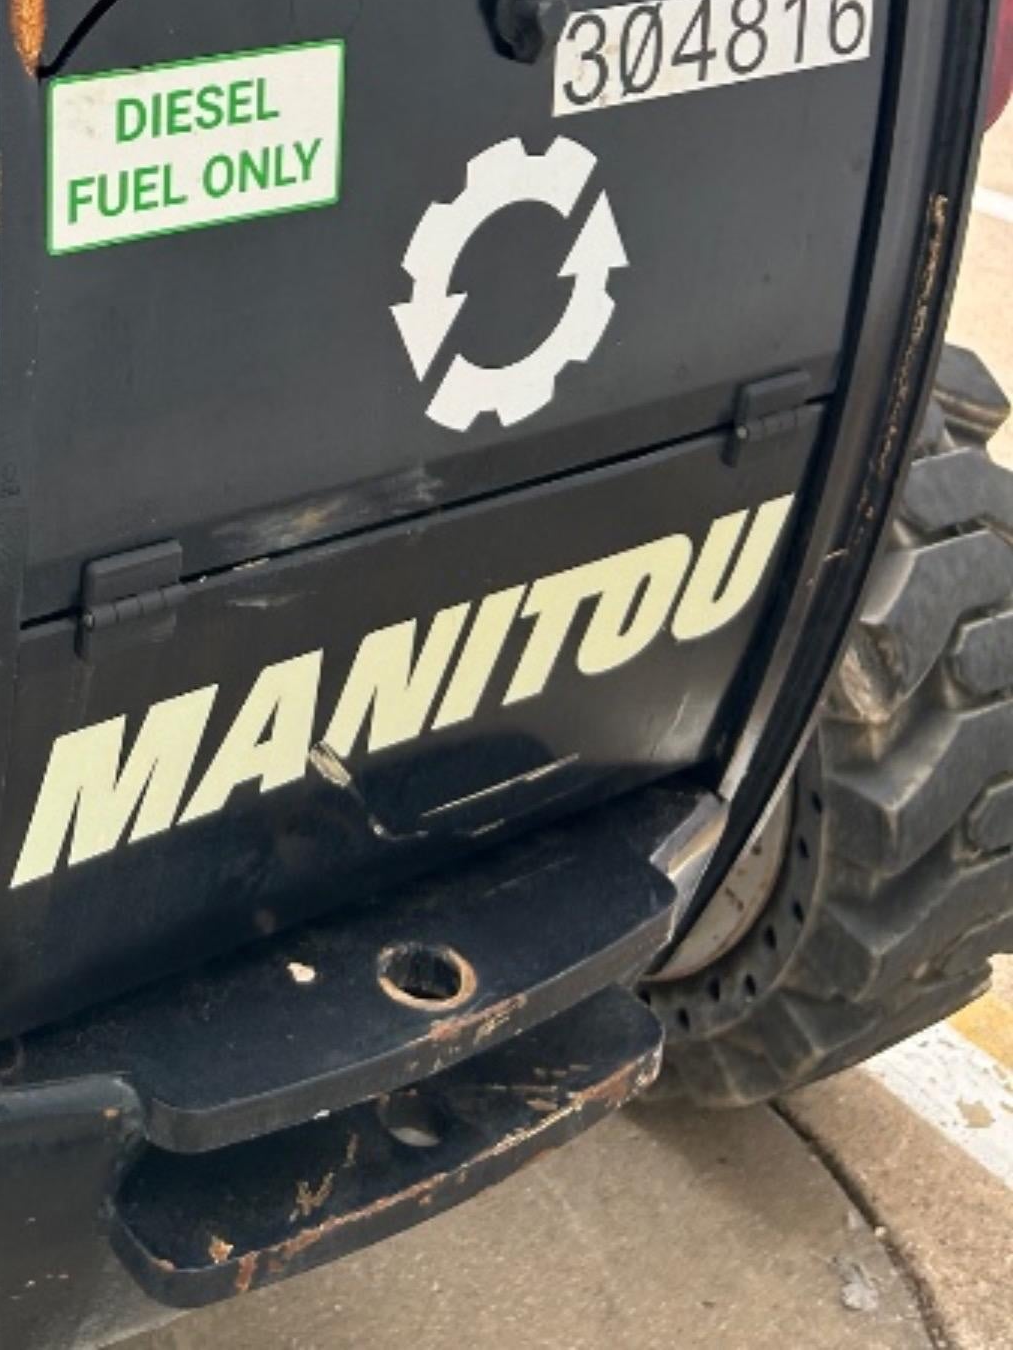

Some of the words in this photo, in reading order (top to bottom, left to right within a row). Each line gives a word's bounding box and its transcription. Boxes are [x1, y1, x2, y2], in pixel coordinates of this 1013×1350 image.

[115, 77, 280, 145] DIESEL
[67, 162, 189, 225] FUEL
[201, 137, 323, 199] ONLY
[8, 491, 797, 891] MANITOU
